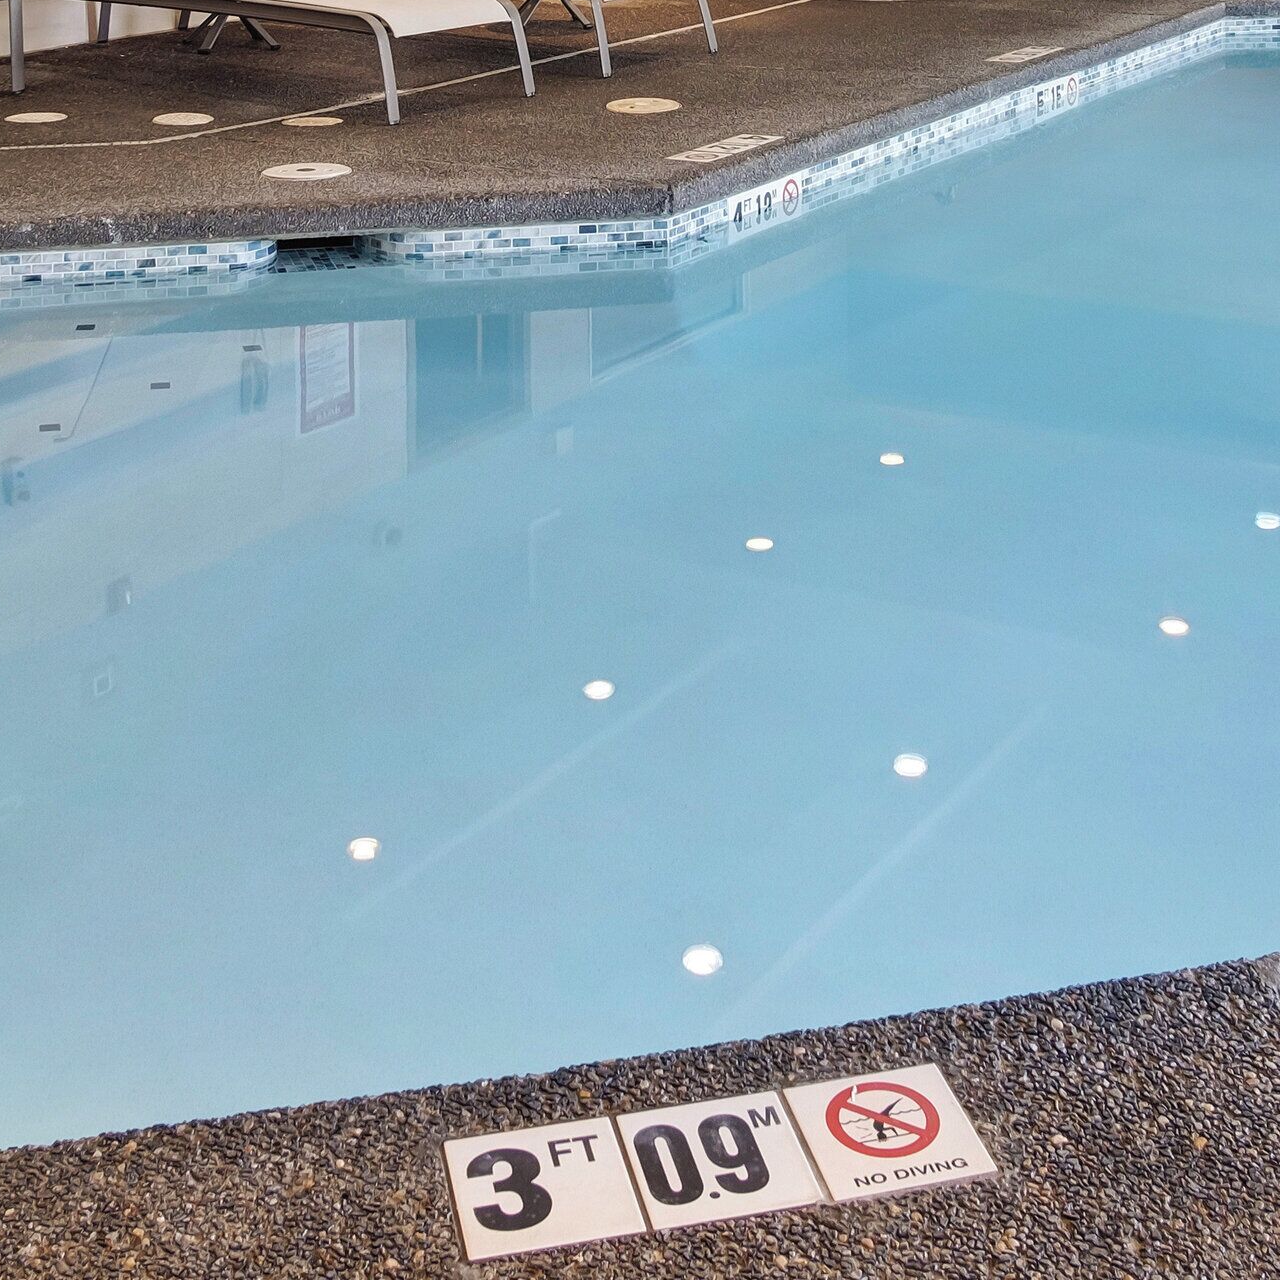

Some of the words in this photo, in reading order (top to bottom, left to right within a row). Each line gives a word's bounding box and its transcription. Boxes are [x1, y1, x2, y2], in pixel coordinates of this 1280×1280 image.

[744, 198, 751, 212] FT
[467, 1148, 553, 1231] 3
[547, 1134, 599, 1167] FT
[633, 1114, 770, 1205] 0.9
[747, 1106, 781, 1129] M
[853, 1173, 887, 1188] NO
[893, 1158, 969, 1180] DIVING
